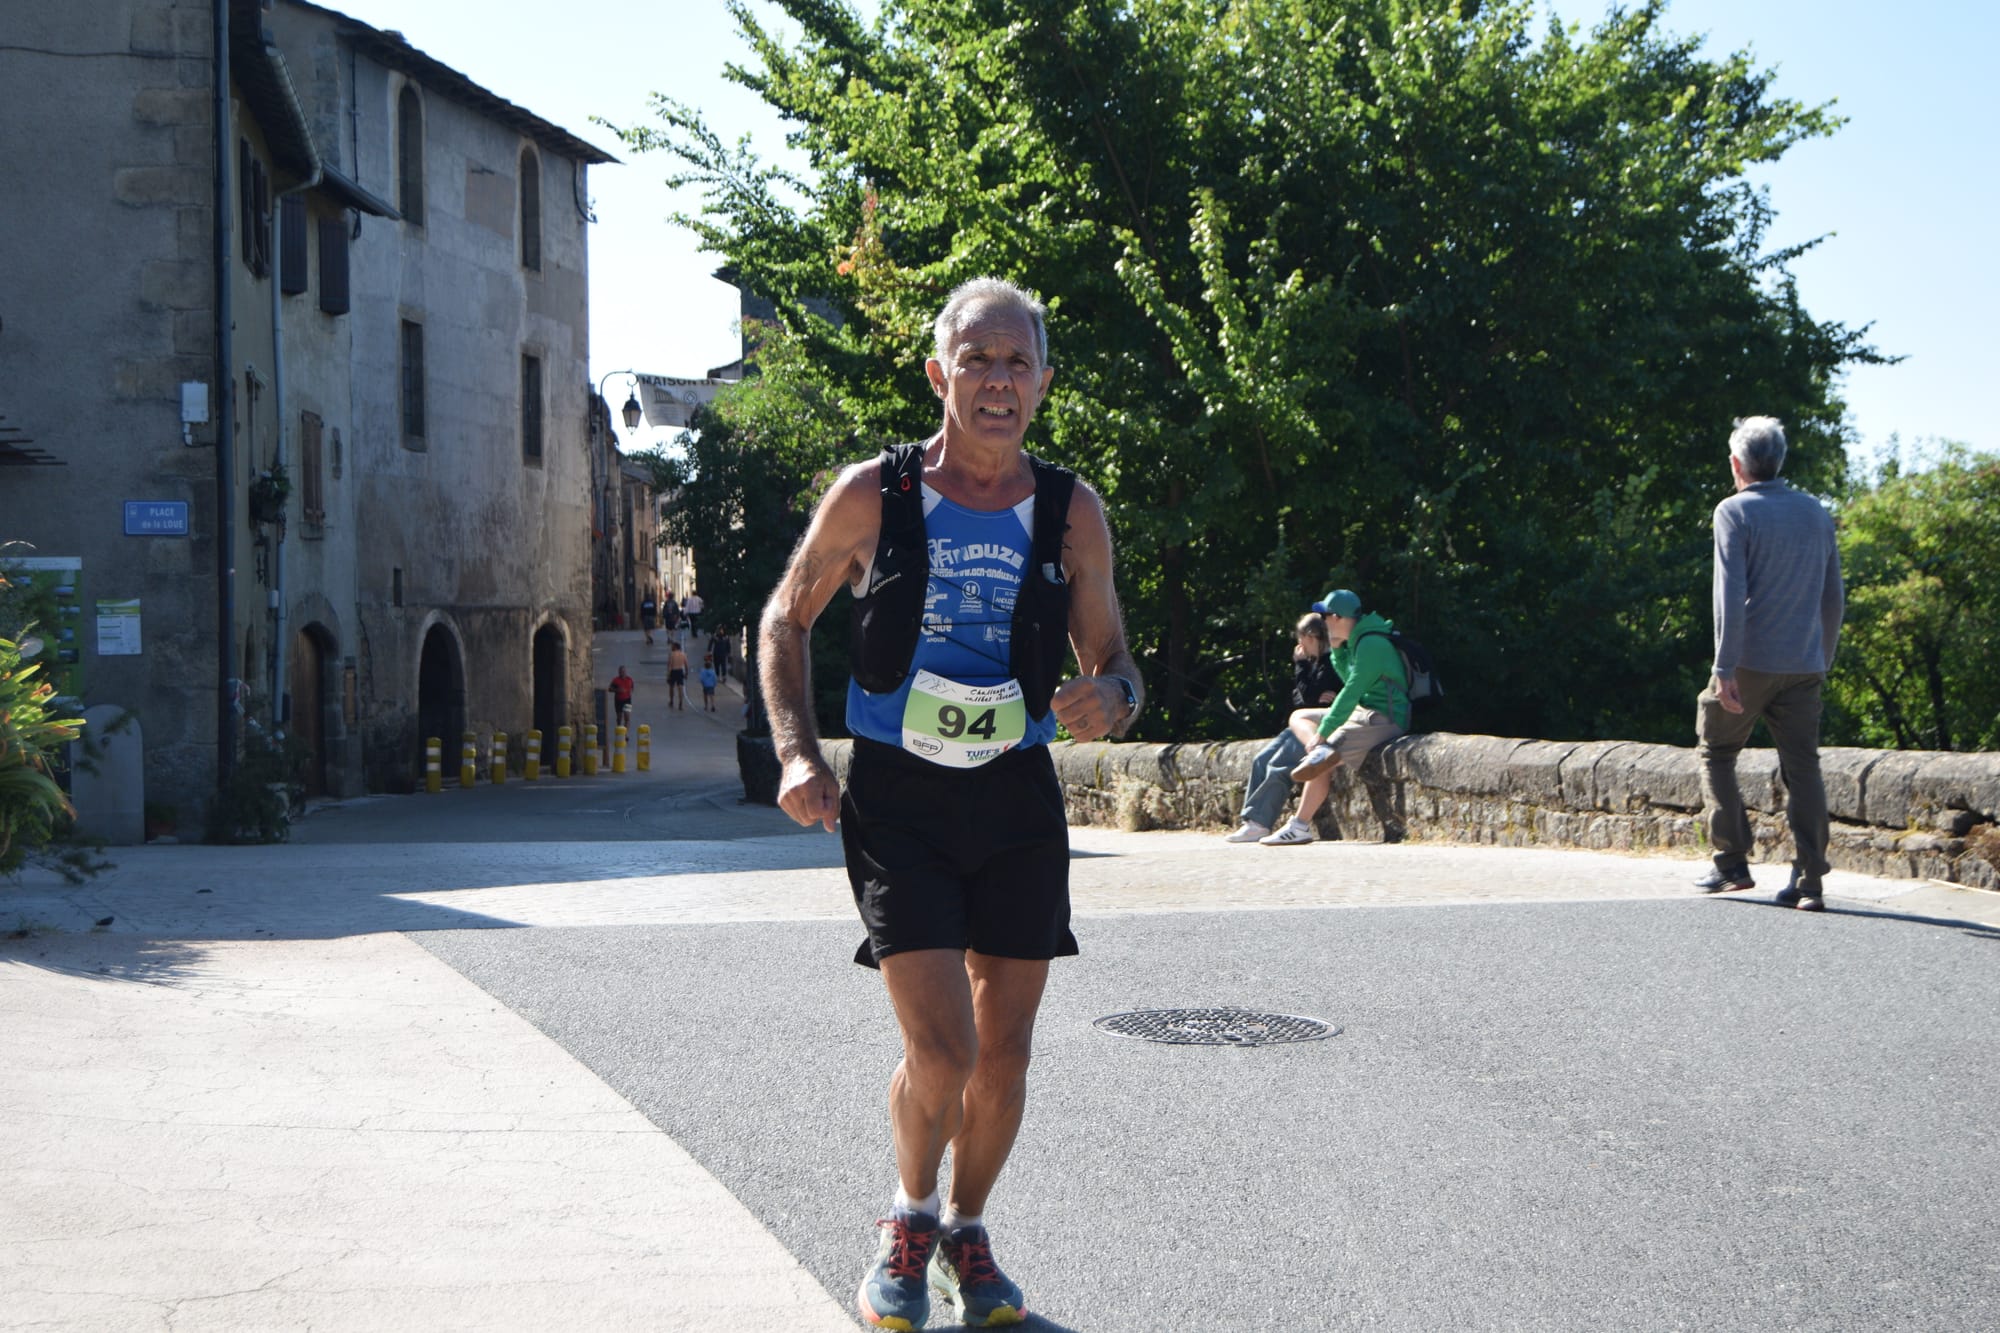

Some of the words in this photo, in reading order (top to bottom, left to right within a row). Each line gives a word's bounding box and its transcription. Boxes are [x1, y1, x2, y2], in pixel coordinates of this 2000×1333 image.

[642, 376, 696, 386] MAISON
[150, 507, 174, 517] PLACE
[163, 520, 184, 529] LOUE
[937, 705, 997, 740] 94
